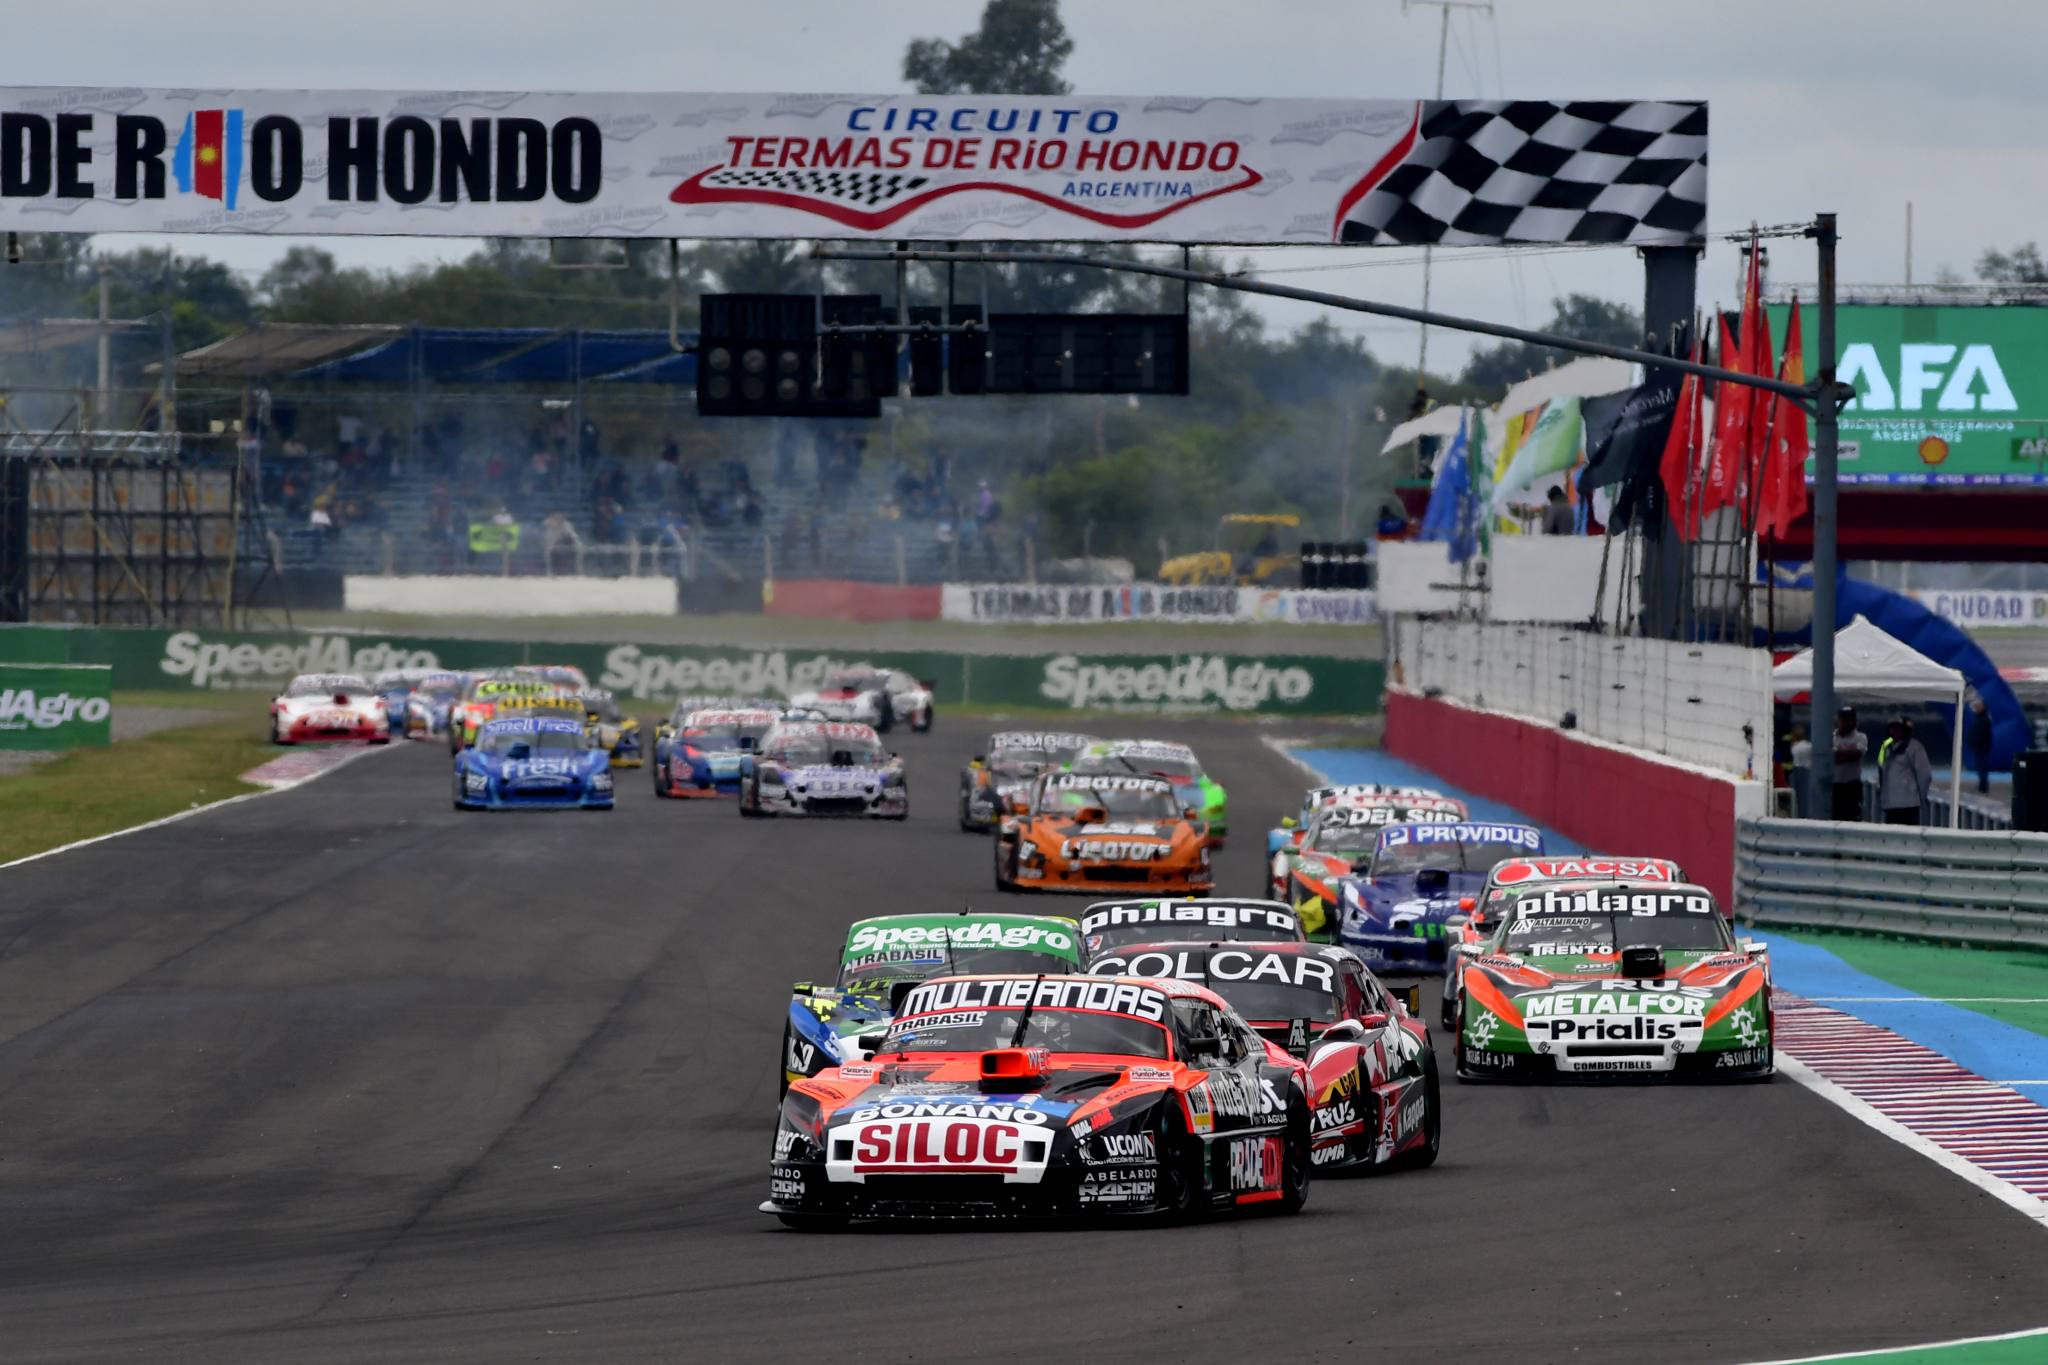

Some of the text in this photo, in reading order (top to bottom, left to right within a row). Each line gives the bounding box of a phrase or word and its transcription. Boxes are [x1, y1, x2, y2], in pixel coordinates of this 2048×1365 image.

[847, 107, 1118, 134] CIRCUITO
[1, 111, 94, 199] DE
[328, 115, 602, 204] HONDO
[727, 136, 913, 168] TERMAS
[922, 136, 979, 169] DE
[1076, 140, 1240, 172] HONDO
[1063, 181, 1194, 198] ARGENTINA
[1836, 342, 2018, 411] AFA
[1937, 594, 2023, 618] CIUDAD
[1041, 656, 1314, 709] SpeedAgro
[1349, 808, 1396, 826] DEL
[1416, 825, 1540, 849] PROVIDUS
[1549, 861, 1665, 880] TACSA
[1516, 889, 1711, 920] philagro
[1082, 901, 1294, 934] philagro
[1533, 917, 1591, 928] ALTAMIRANO
[849, 922, 1071, 952] SpeedAgro
[855, 949, 944, 966] TRABASIL
[1529, 943, 1614, 957] TRENTO
[1088, 951, 1334, 993] COLCAR
[903, 979, 1165, 1021] MULTIBANDAS
[1601, 978, 1714, 999] RUS
[1526, 994, 1706, 1017] METALFOR
[893, 1013, 982, 1034] TRABASIL
[1551, 1016, 1677, 1040] Prialis
[1573, 1060, 1653, 1071] COMBUSTIBLES
[851, 1104, 1048, 1125] BONANO
[1267, 1113, 1288, 1124] AGUA
[1403, 1095, 1425, 1135] Kappa
[857, 1122, 1019, 1164] SILOC
[1084, 1168, 1157, 1182] ABELARDO
